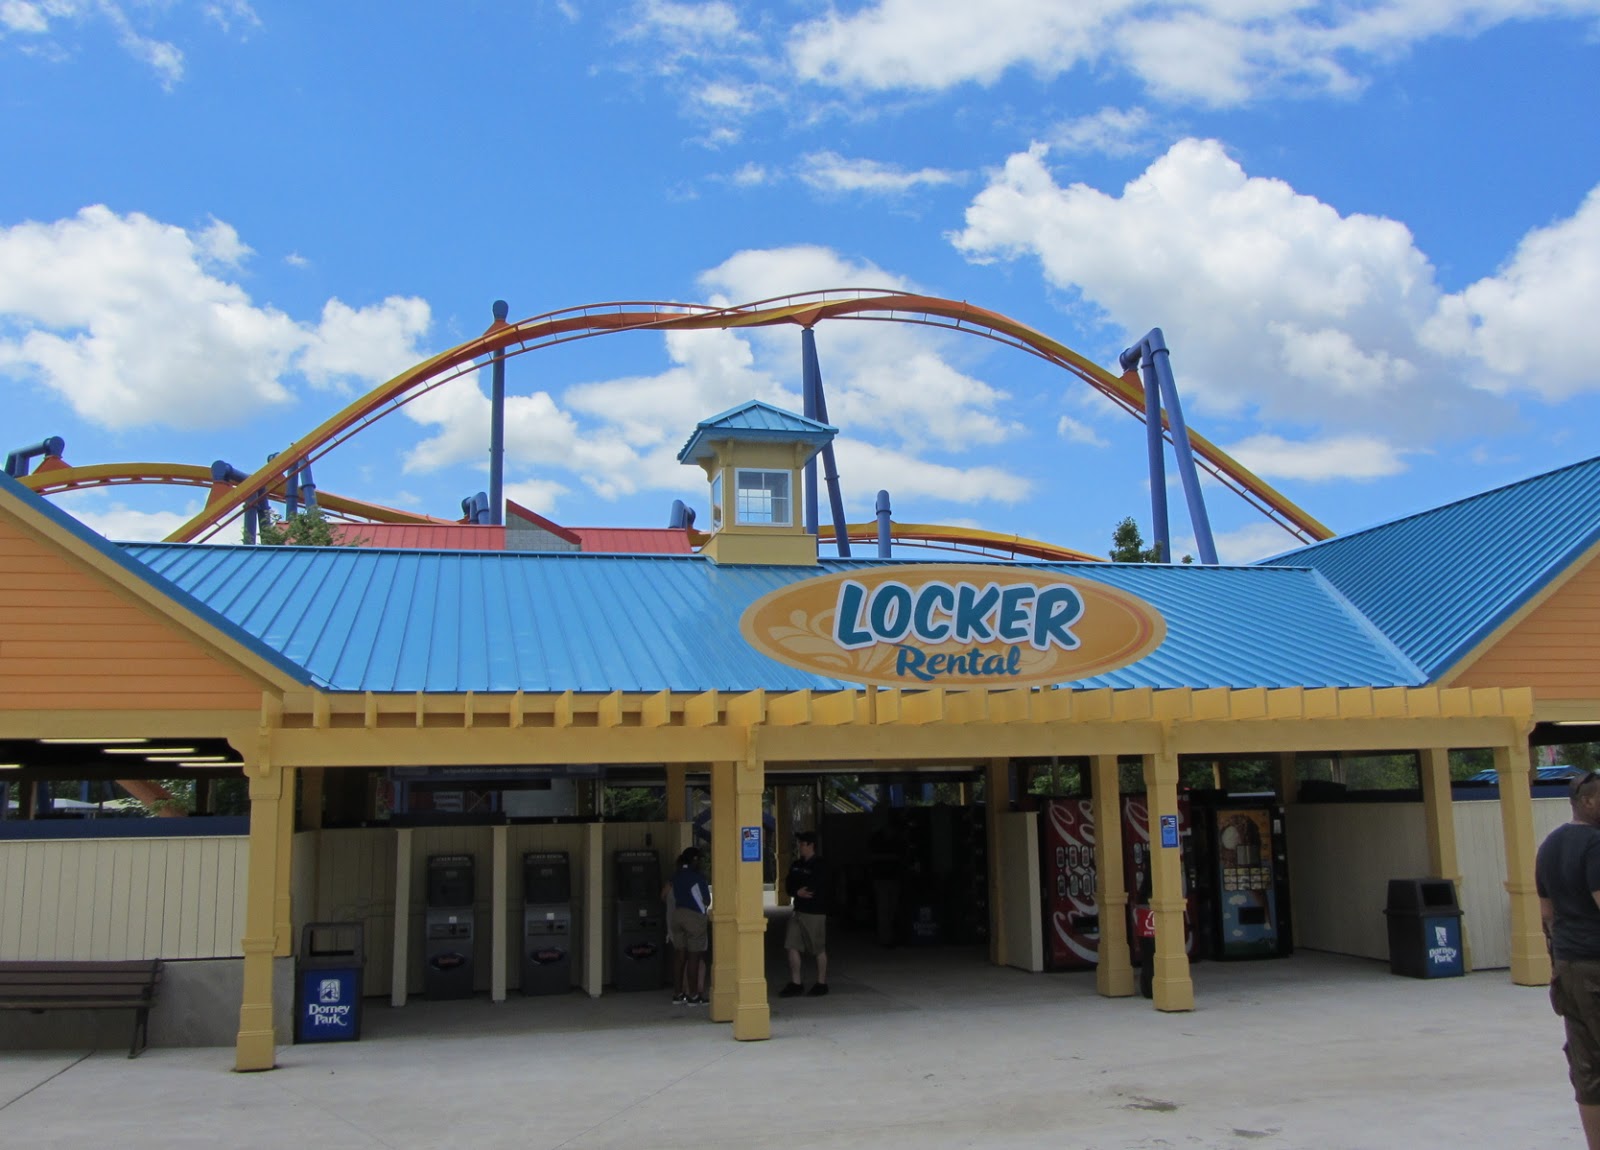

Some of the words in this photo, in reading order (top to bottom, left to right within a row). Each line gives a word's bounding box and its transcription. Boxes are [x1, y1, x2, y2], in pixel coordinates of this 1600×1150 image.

[833, 581, 1084, 651] LOCKER
[894, 644, 1021, 681] Rental
[1429, 947, 1457, 958] Dorney
[1435, 954, 1453, 964] Park
[308, 1004, 350, 1015] Dorney
[314, 1013, 348, 1026] Park
